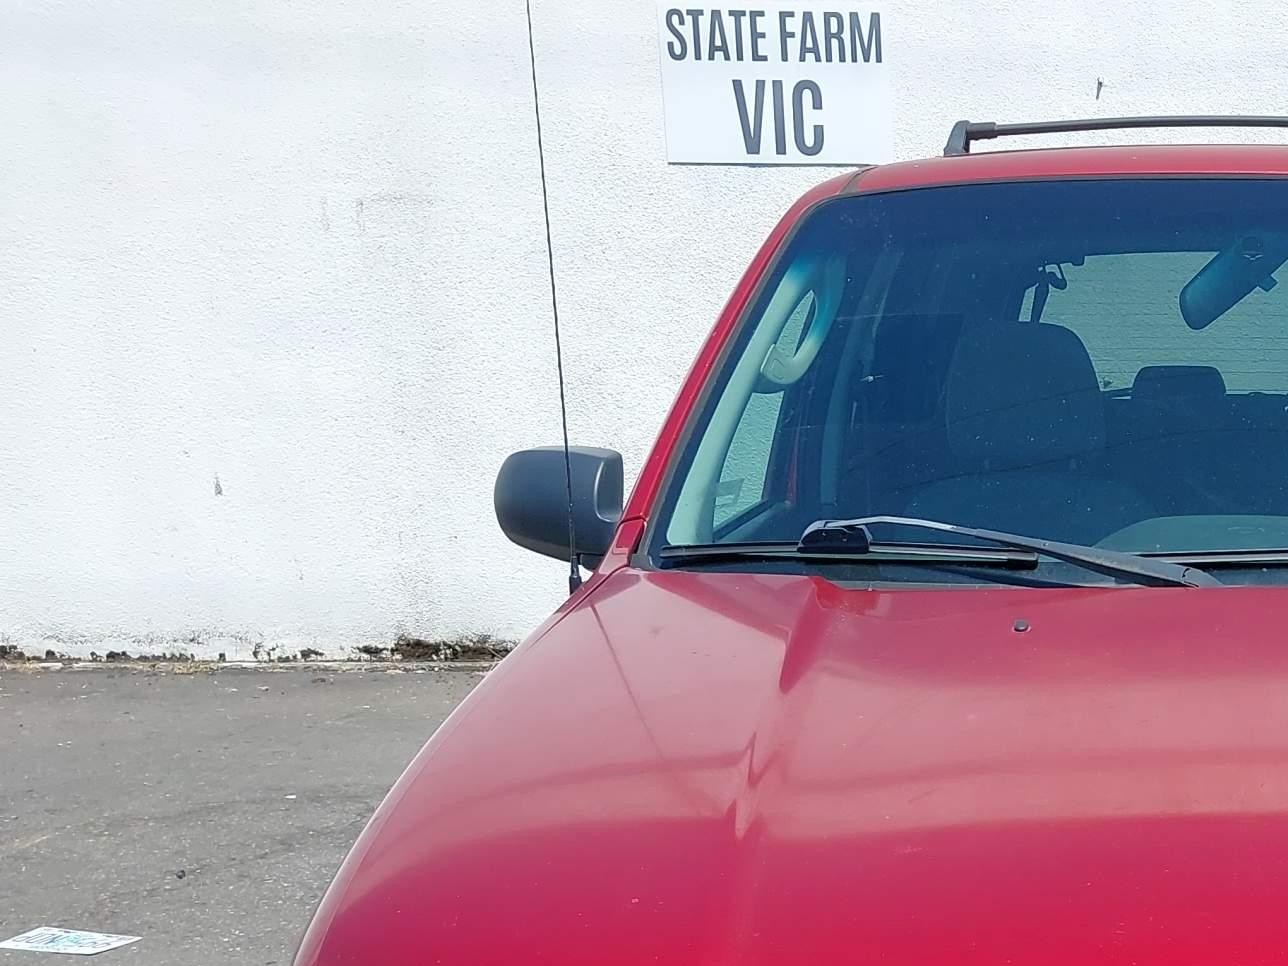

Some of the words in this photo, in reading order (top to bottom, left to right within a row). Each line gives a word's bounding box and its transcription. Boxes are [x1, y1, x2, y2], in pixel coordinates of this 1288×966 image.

[665, 8, 768, 62] STATE
[778, 10, 883, 63] FARM
[732, 79, 825, 156] VIC
